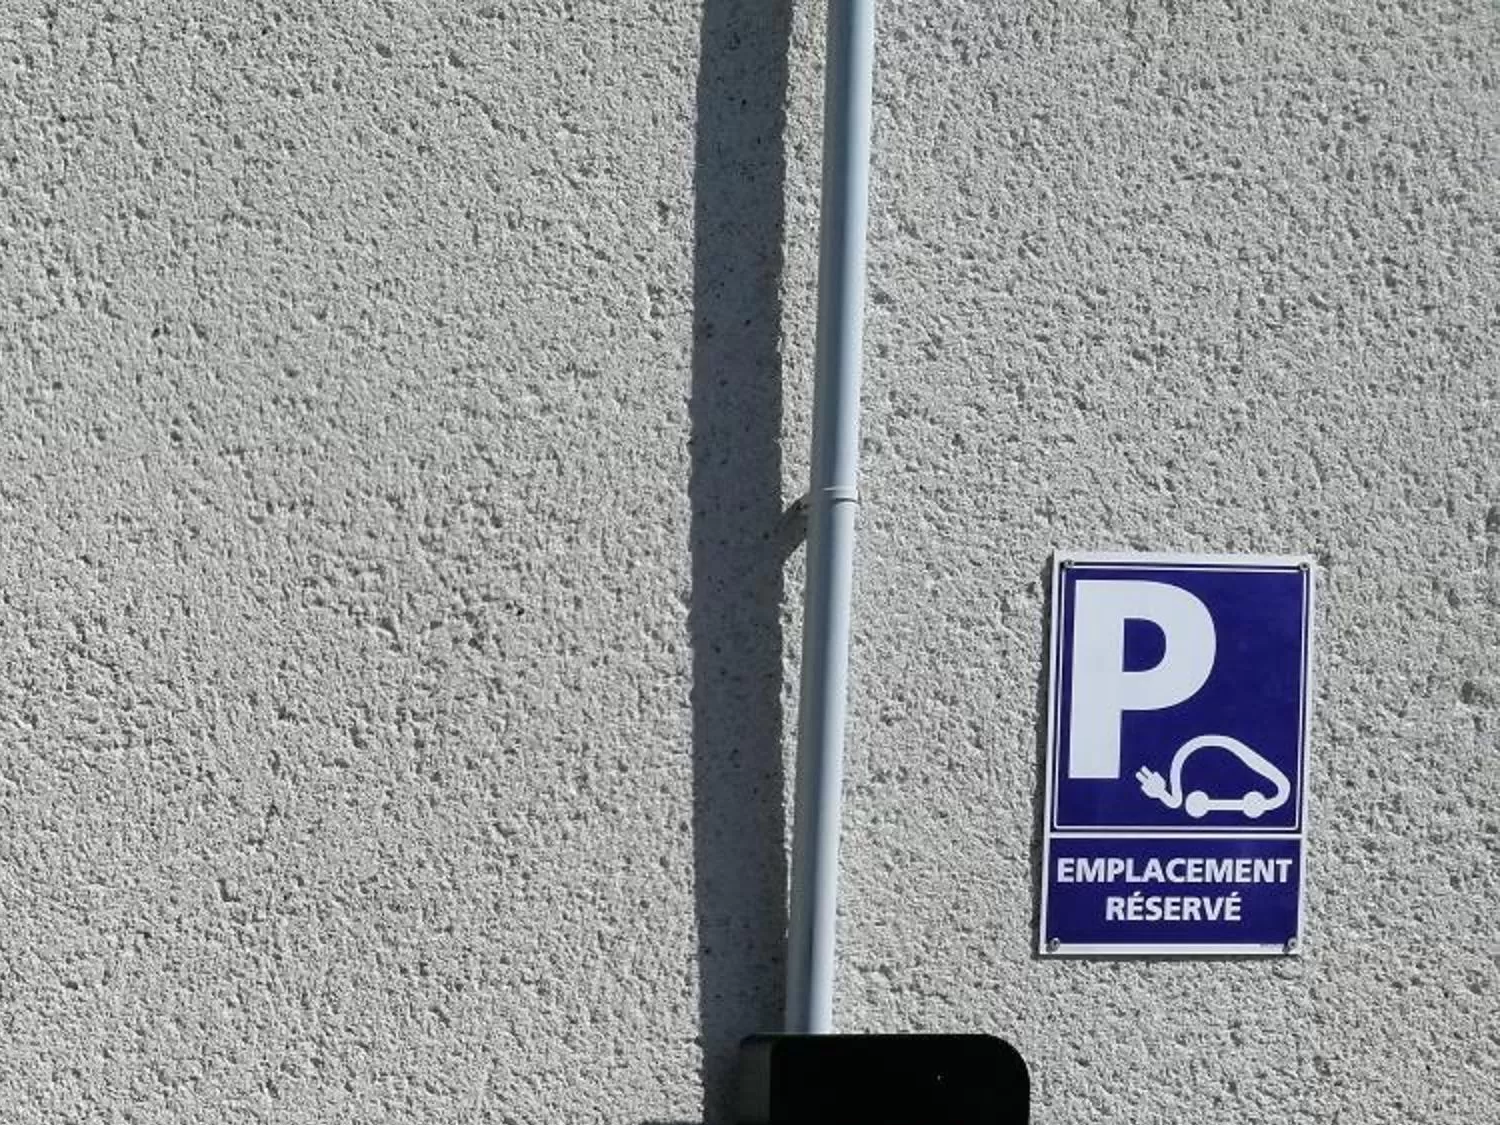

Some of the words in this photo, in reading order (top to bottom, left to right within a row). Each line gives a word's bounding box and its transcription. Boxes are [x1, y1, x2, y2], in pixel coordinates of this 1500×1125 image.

[1068, 579, 1217, 779] P
[1057, 858, 1293, 884] EMPLACEMENT
[1106, 891, 1241, 921] RÉSERVÉ
